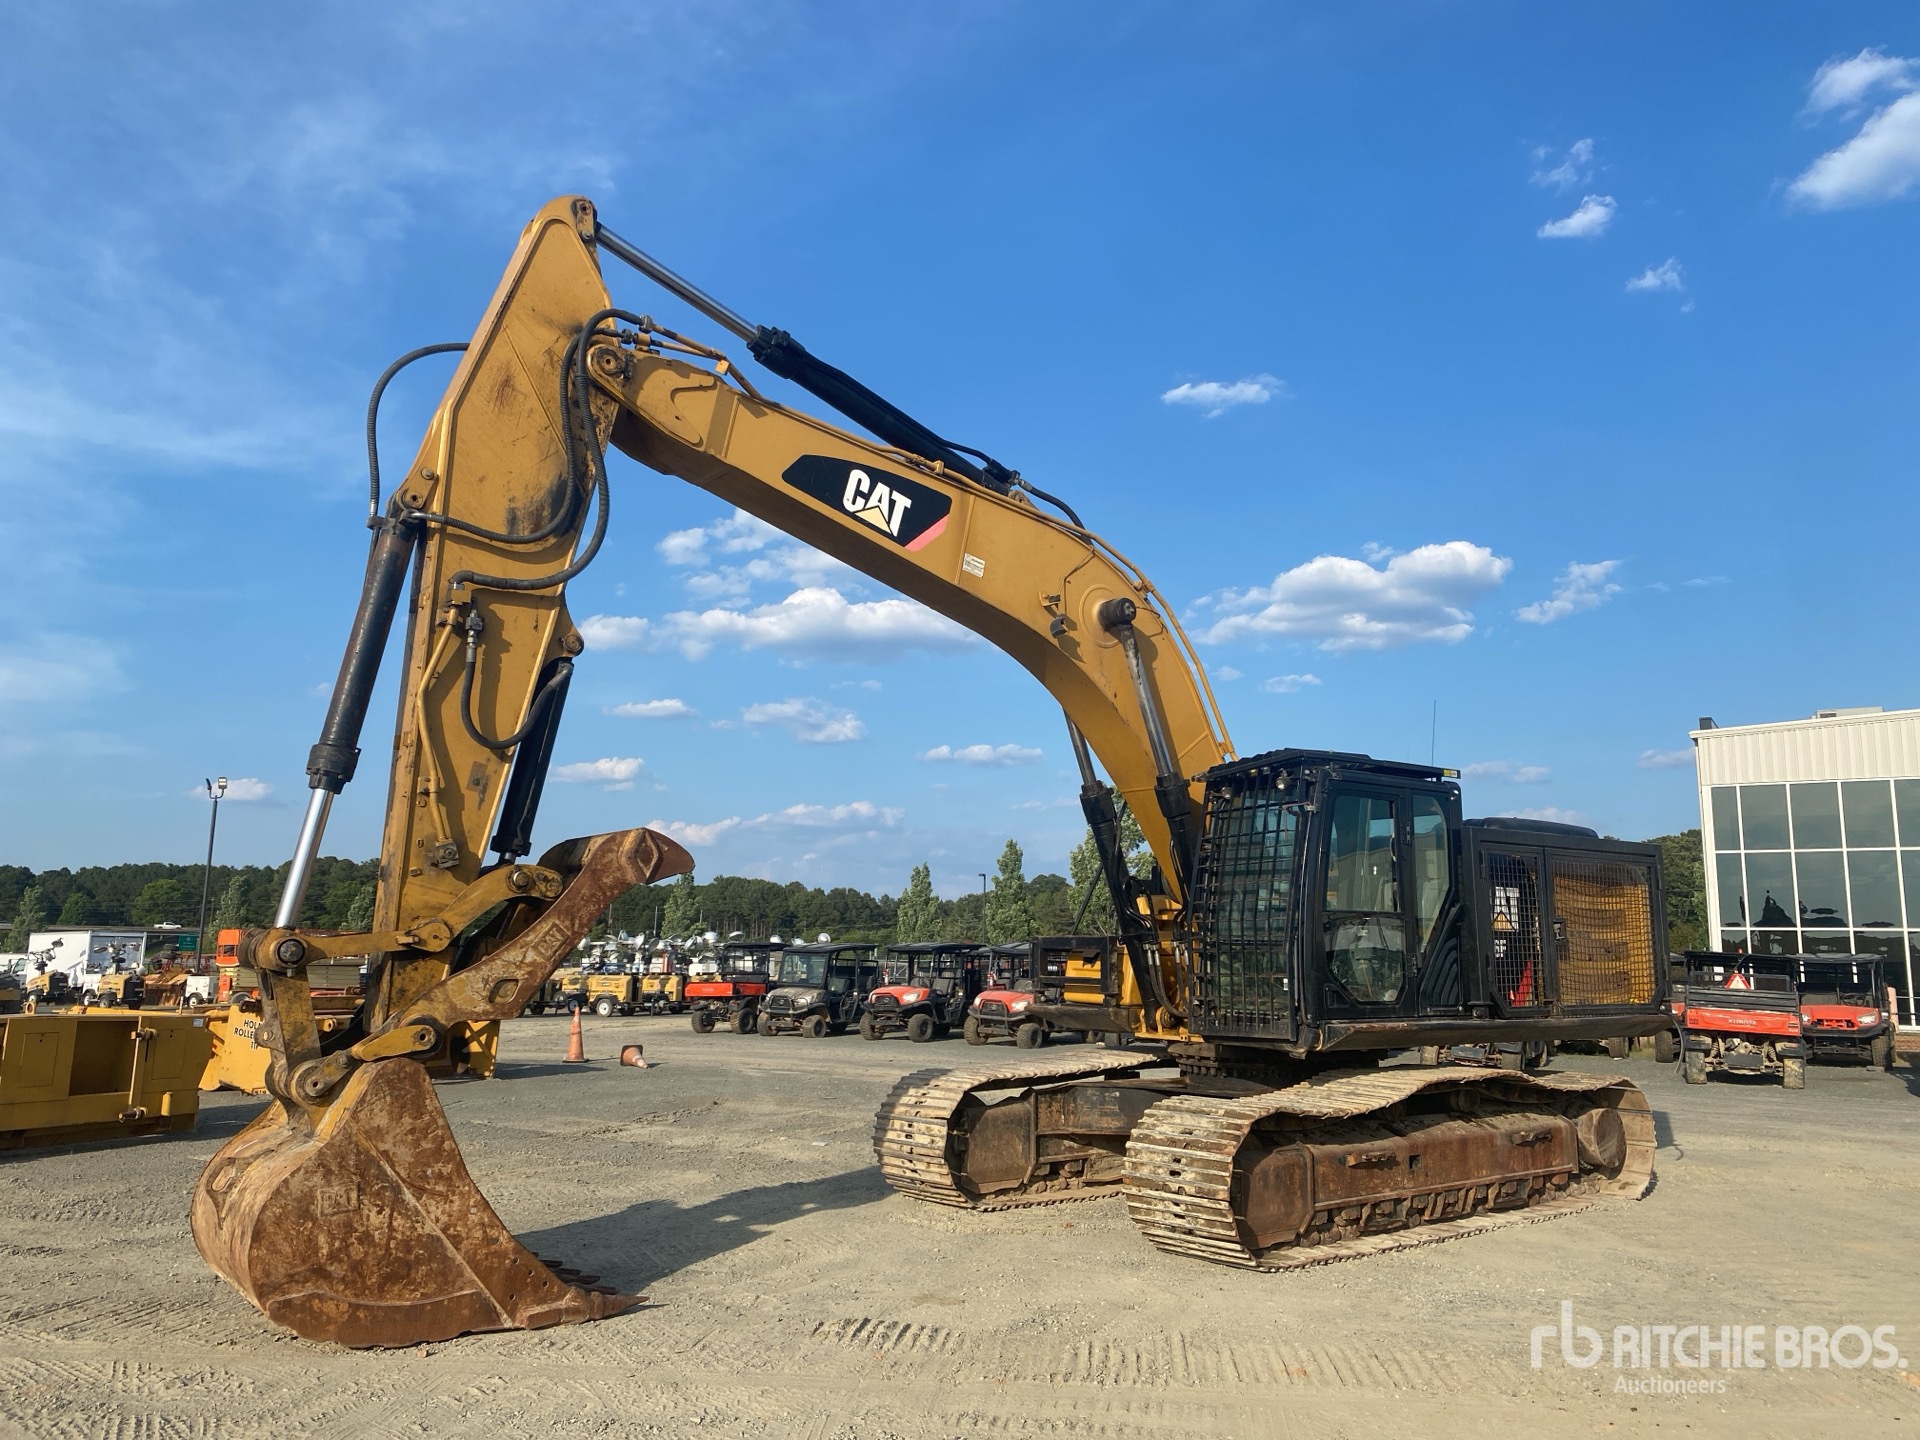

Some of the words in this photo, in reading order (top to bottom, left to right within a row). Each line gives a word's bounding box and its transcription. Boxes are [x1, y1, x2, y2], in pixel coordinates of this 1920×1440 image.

[843, 469, 912, 537] CAT
[1491, 886, 1520, 932] AT
[233, 1027, 255, 1040] ROLLE
[243, 1019, 262, 1030] HOL
